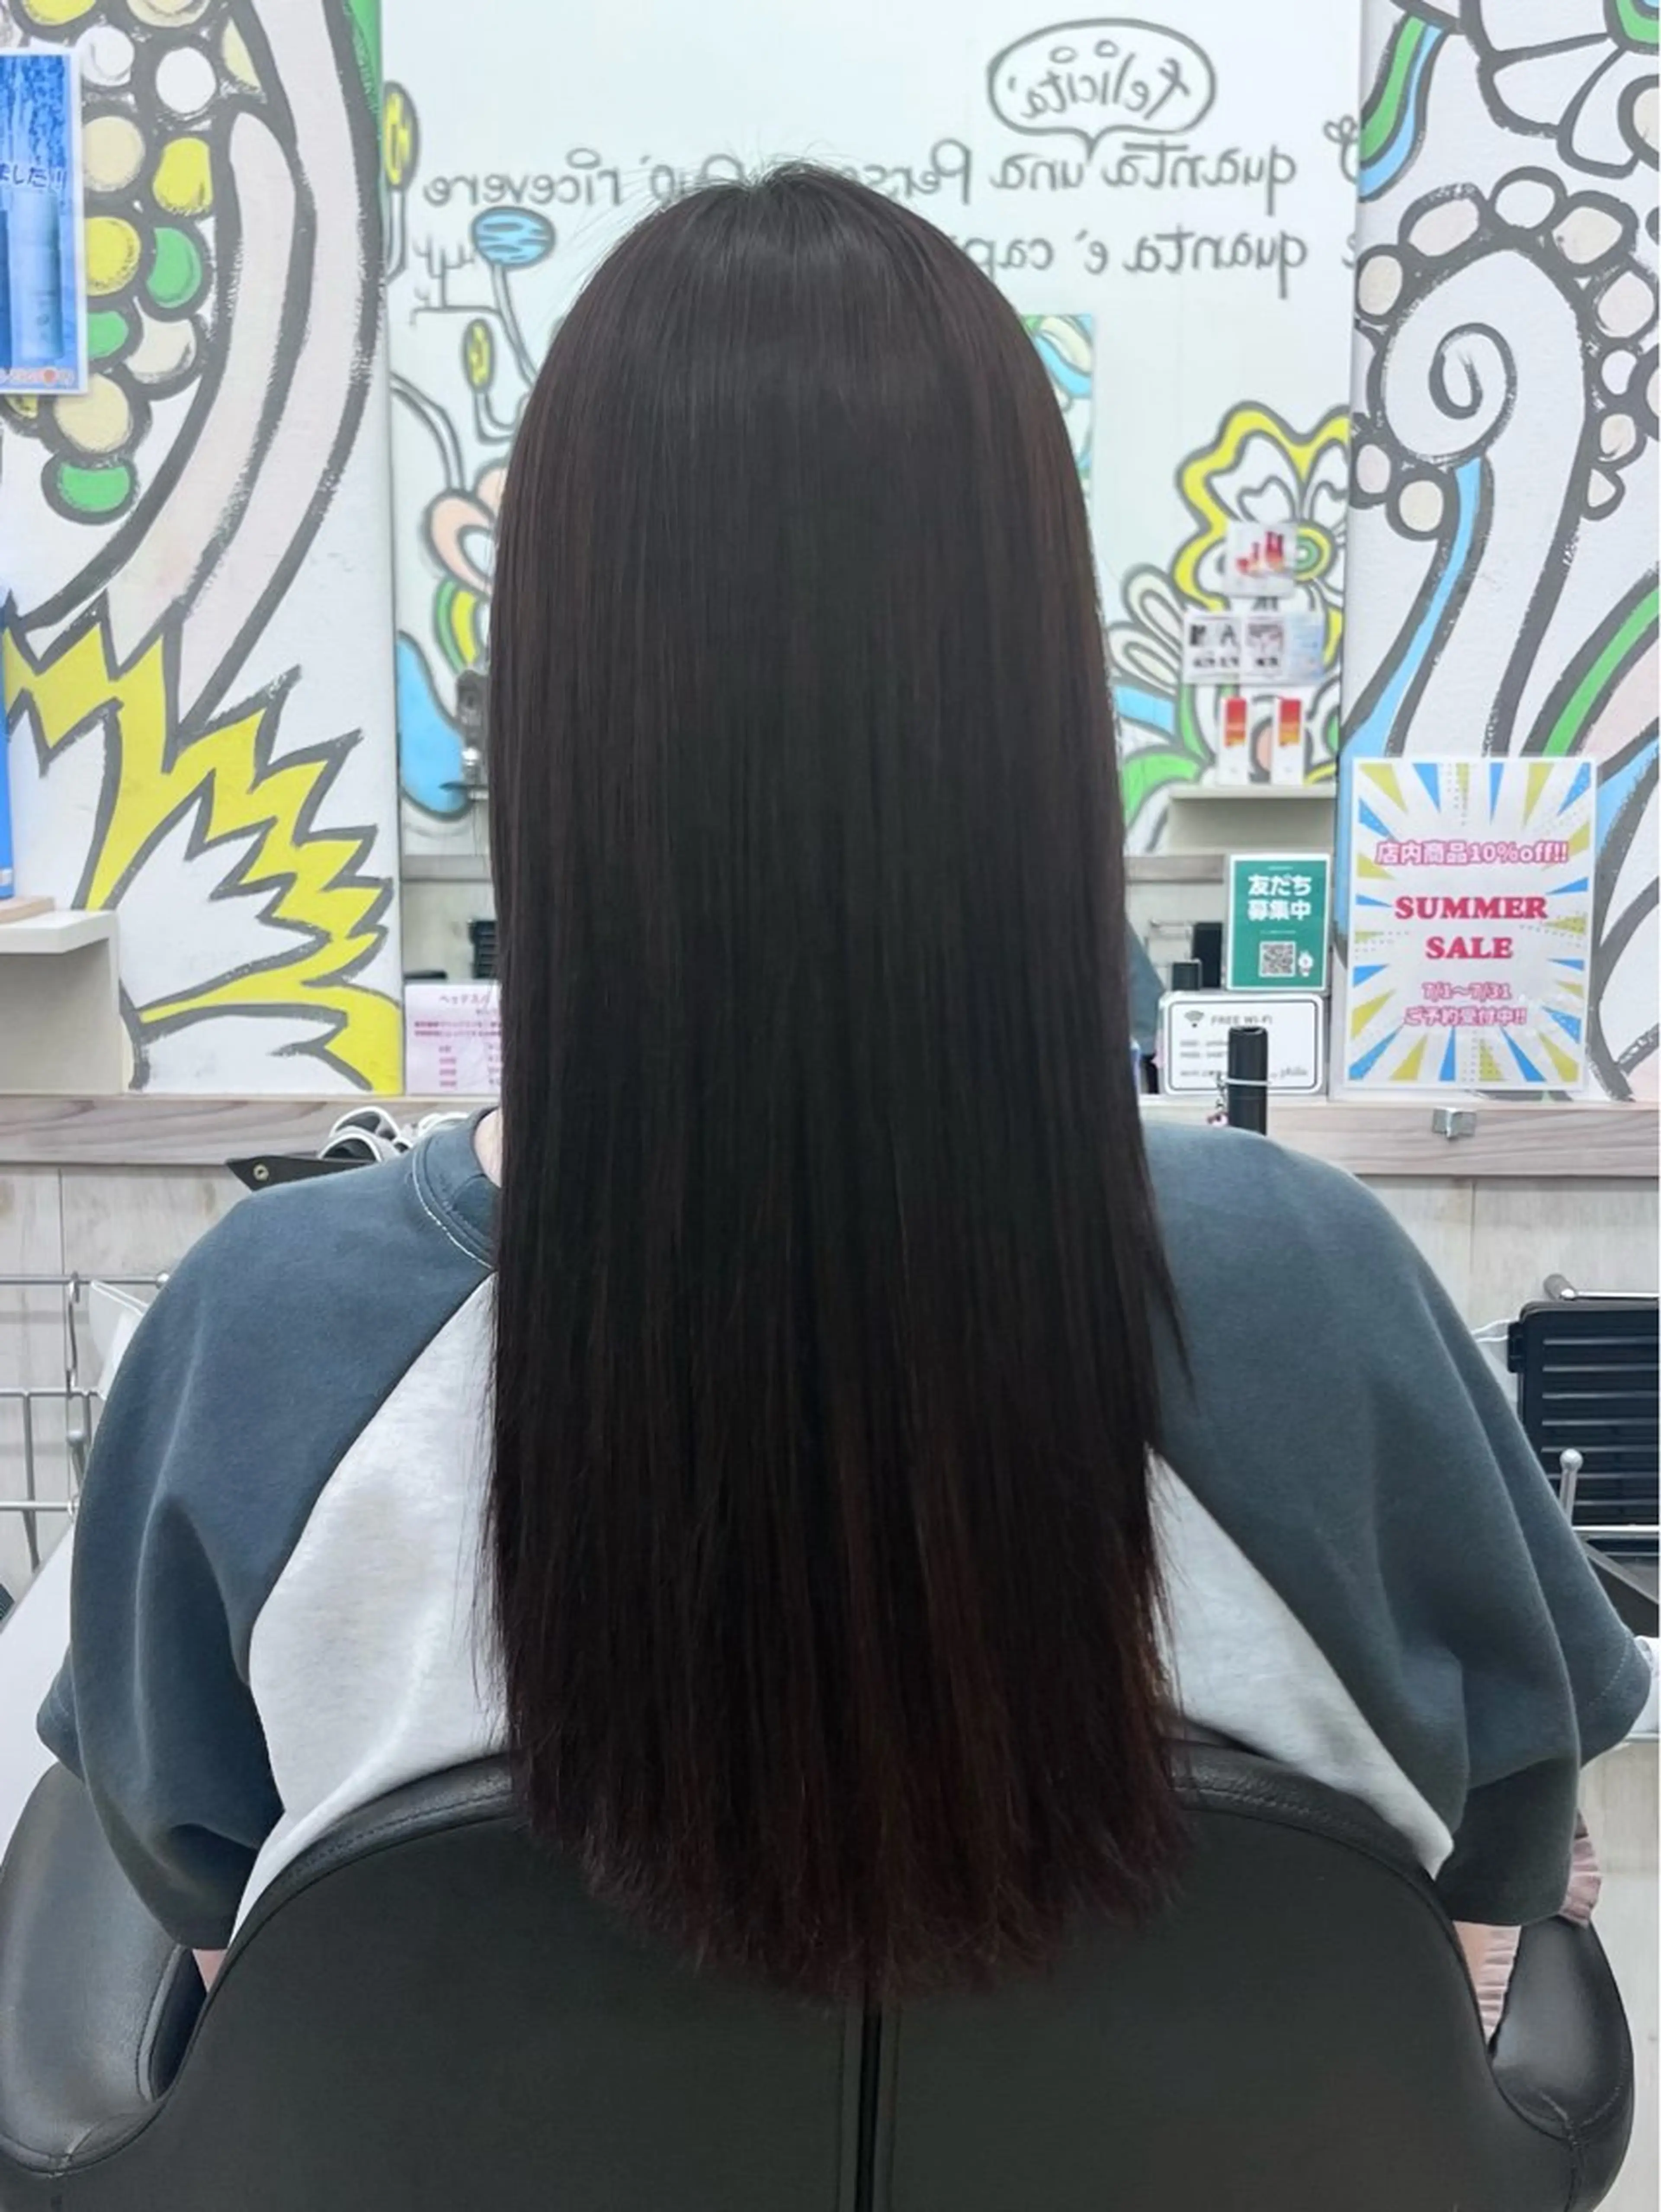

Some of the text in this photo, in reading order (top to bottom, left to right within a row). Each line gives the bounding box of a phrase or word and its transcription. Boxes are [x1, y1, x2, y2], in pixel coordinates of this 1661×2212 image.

[1248, 873, 1312, 896] 友だち
[1248, 899, 1312, 921] 募集中
[1395, 896, 1548, 919] SUMMER
[1426, 936, 1513, 959] SALE
[1211, 1015, 1240, 1025] FREE
